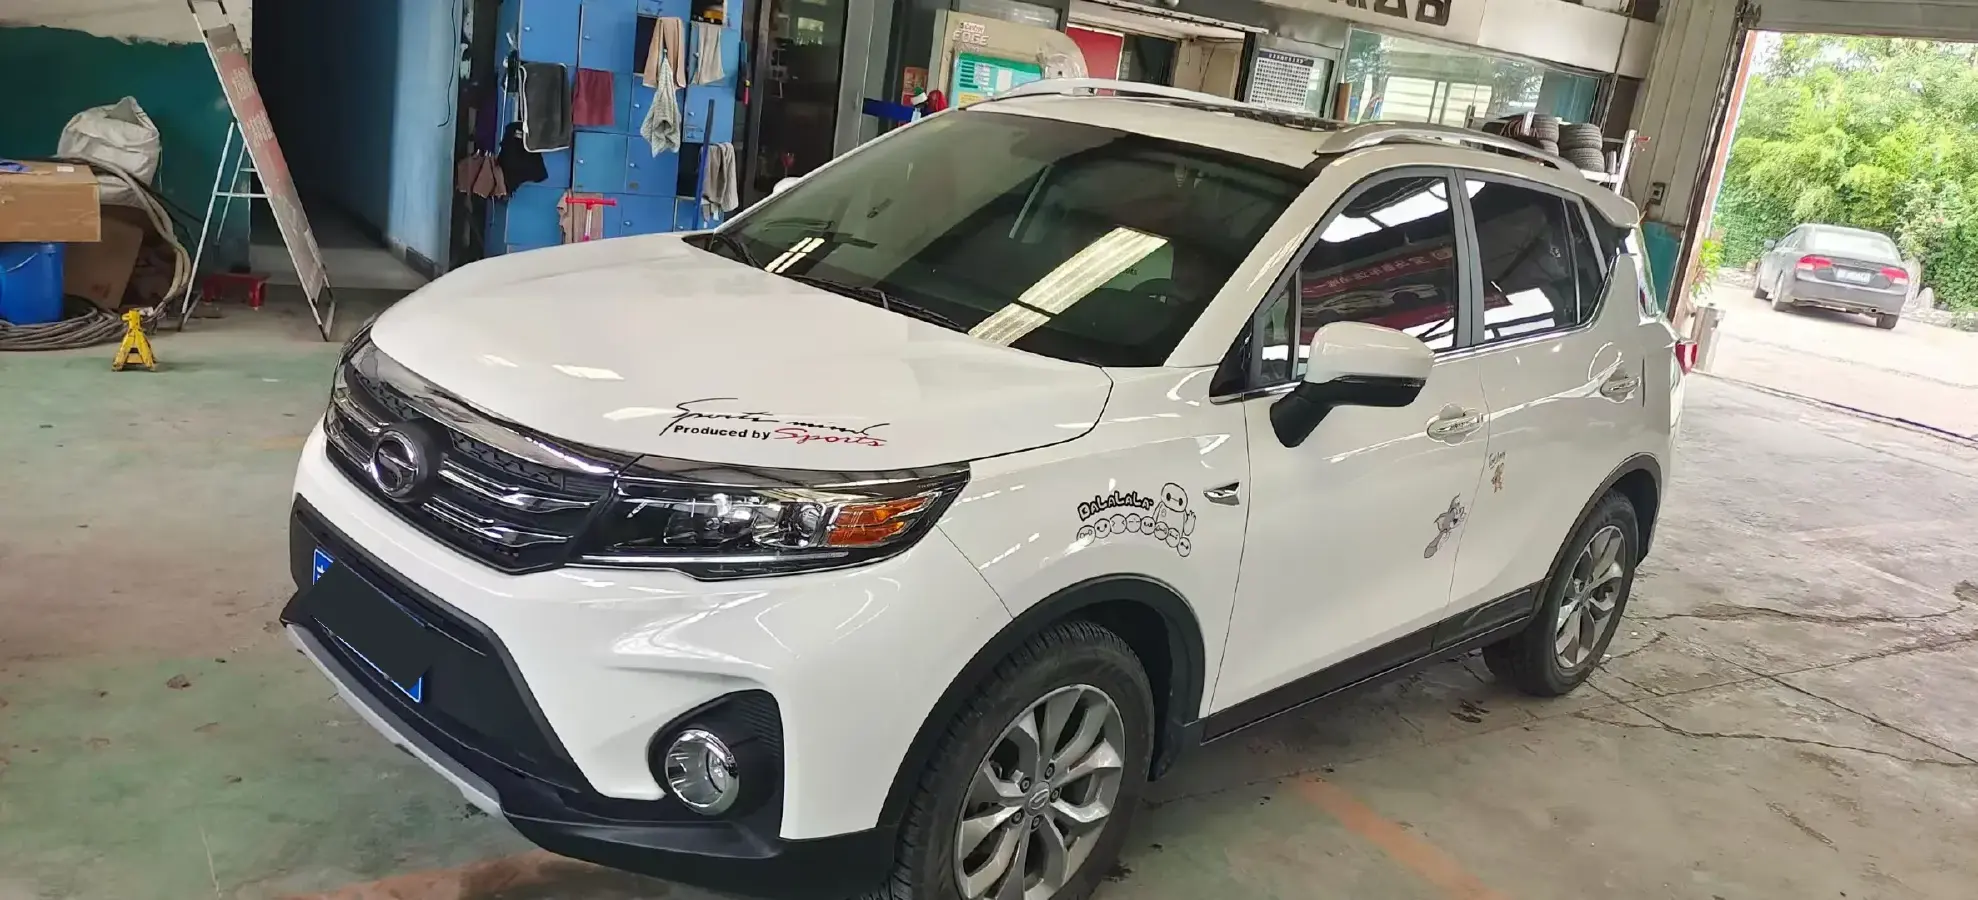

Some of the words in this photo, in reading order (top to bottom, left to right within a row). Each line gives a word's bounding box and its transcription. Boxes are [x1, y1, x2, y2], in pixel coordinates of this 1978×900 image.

[952, 30, 990, 46] EDGE
[673, 425, 748, 439] Produced
[752, 429, 771, 440] by
[773, 428, 888, 447] Sports
